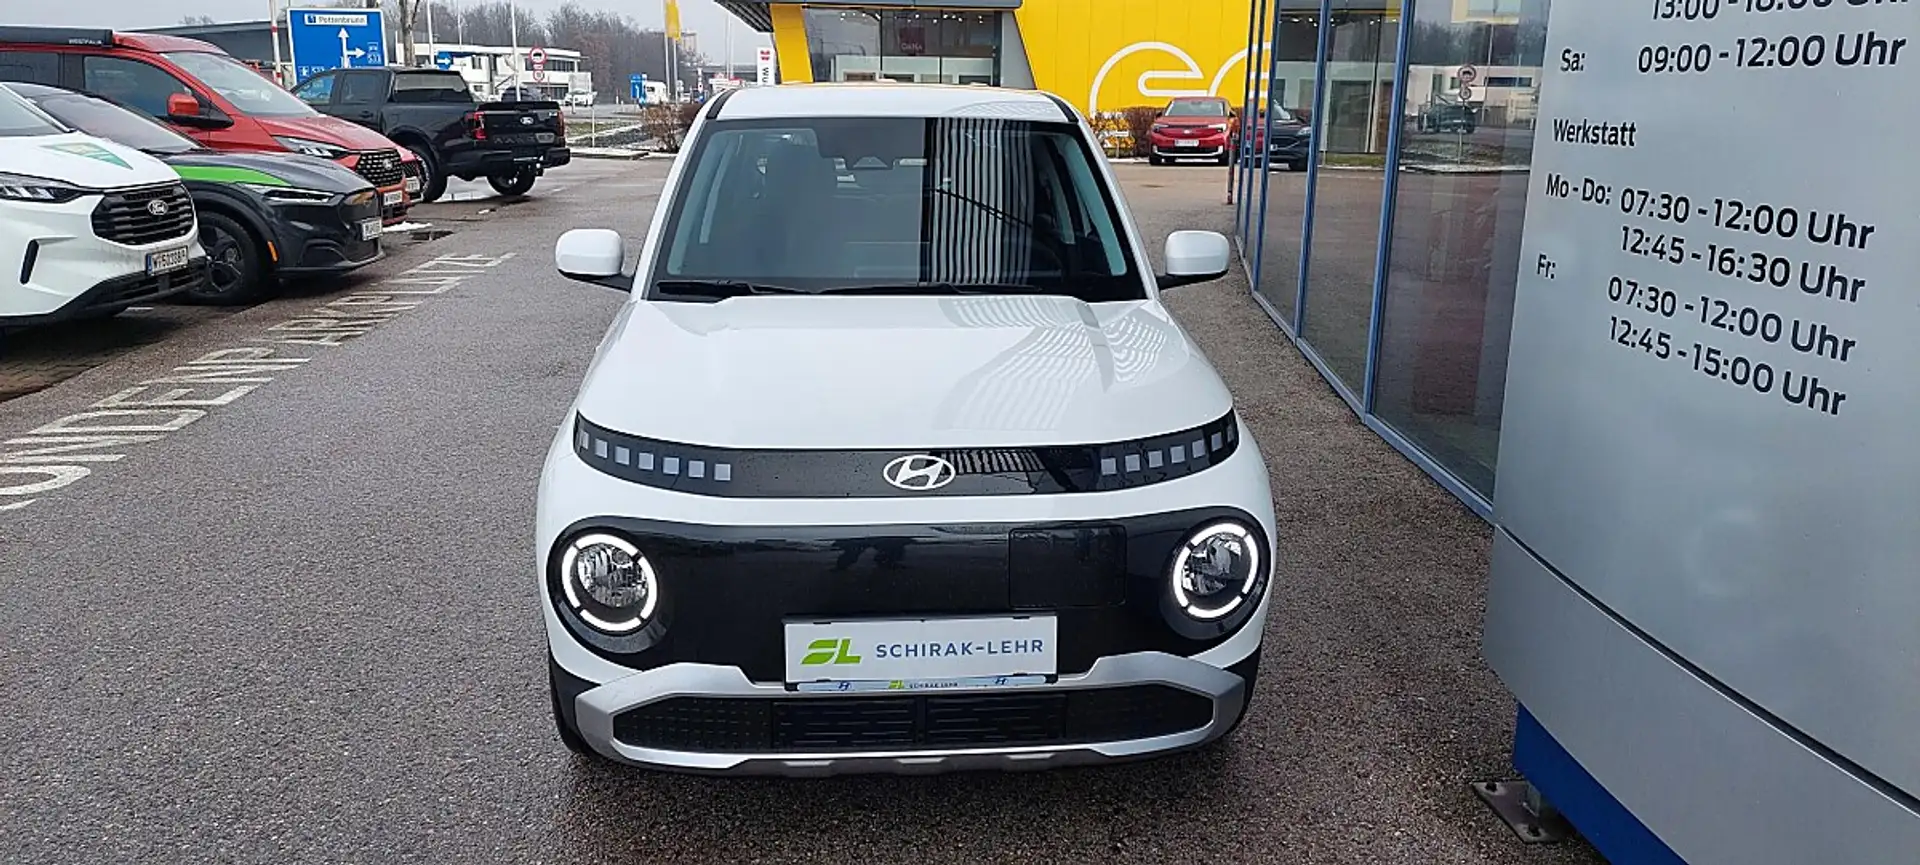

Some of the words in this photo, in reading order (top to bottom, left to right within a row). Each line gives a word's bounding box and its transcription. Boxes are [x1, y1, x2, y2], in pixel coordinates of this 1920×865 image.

[1653, 0, 1720, 20] 13:00
[1560, 48, 1586, 72] Sa:
[1638, 44, 1712, 73] 09:00
[1736, 36, 1825, 68] 12:00
[1835, 31, 1907, 66] Uhr
[1553, 118, 1637, 147] Werkstatt
[1620, 187, 1690, 224] 07:30
[1714, 198, 1798, 238] 12:00
[1807, 211, 1875, 249] Uhr
[1622, 225, 1685, 265] 12:45
[1708, 244, 1791, 288] 16:30
[1799, 262, 1866, 303] Uhr
[1536, 253, 1556, 280] Fr:
[1608, 276, 1677, 318] 07:30
[1700, 295, 1782, 343] 12:00
[1791, 319, 1856, 362] Uhr
[1610, 315, 1671, 360] 12:45
[1693, 343, 1774, 393] 15:00
[1782, 371, 1846, 416] Uhr
[876, 639, 1043, 658] SCHIRAK-LEHR
